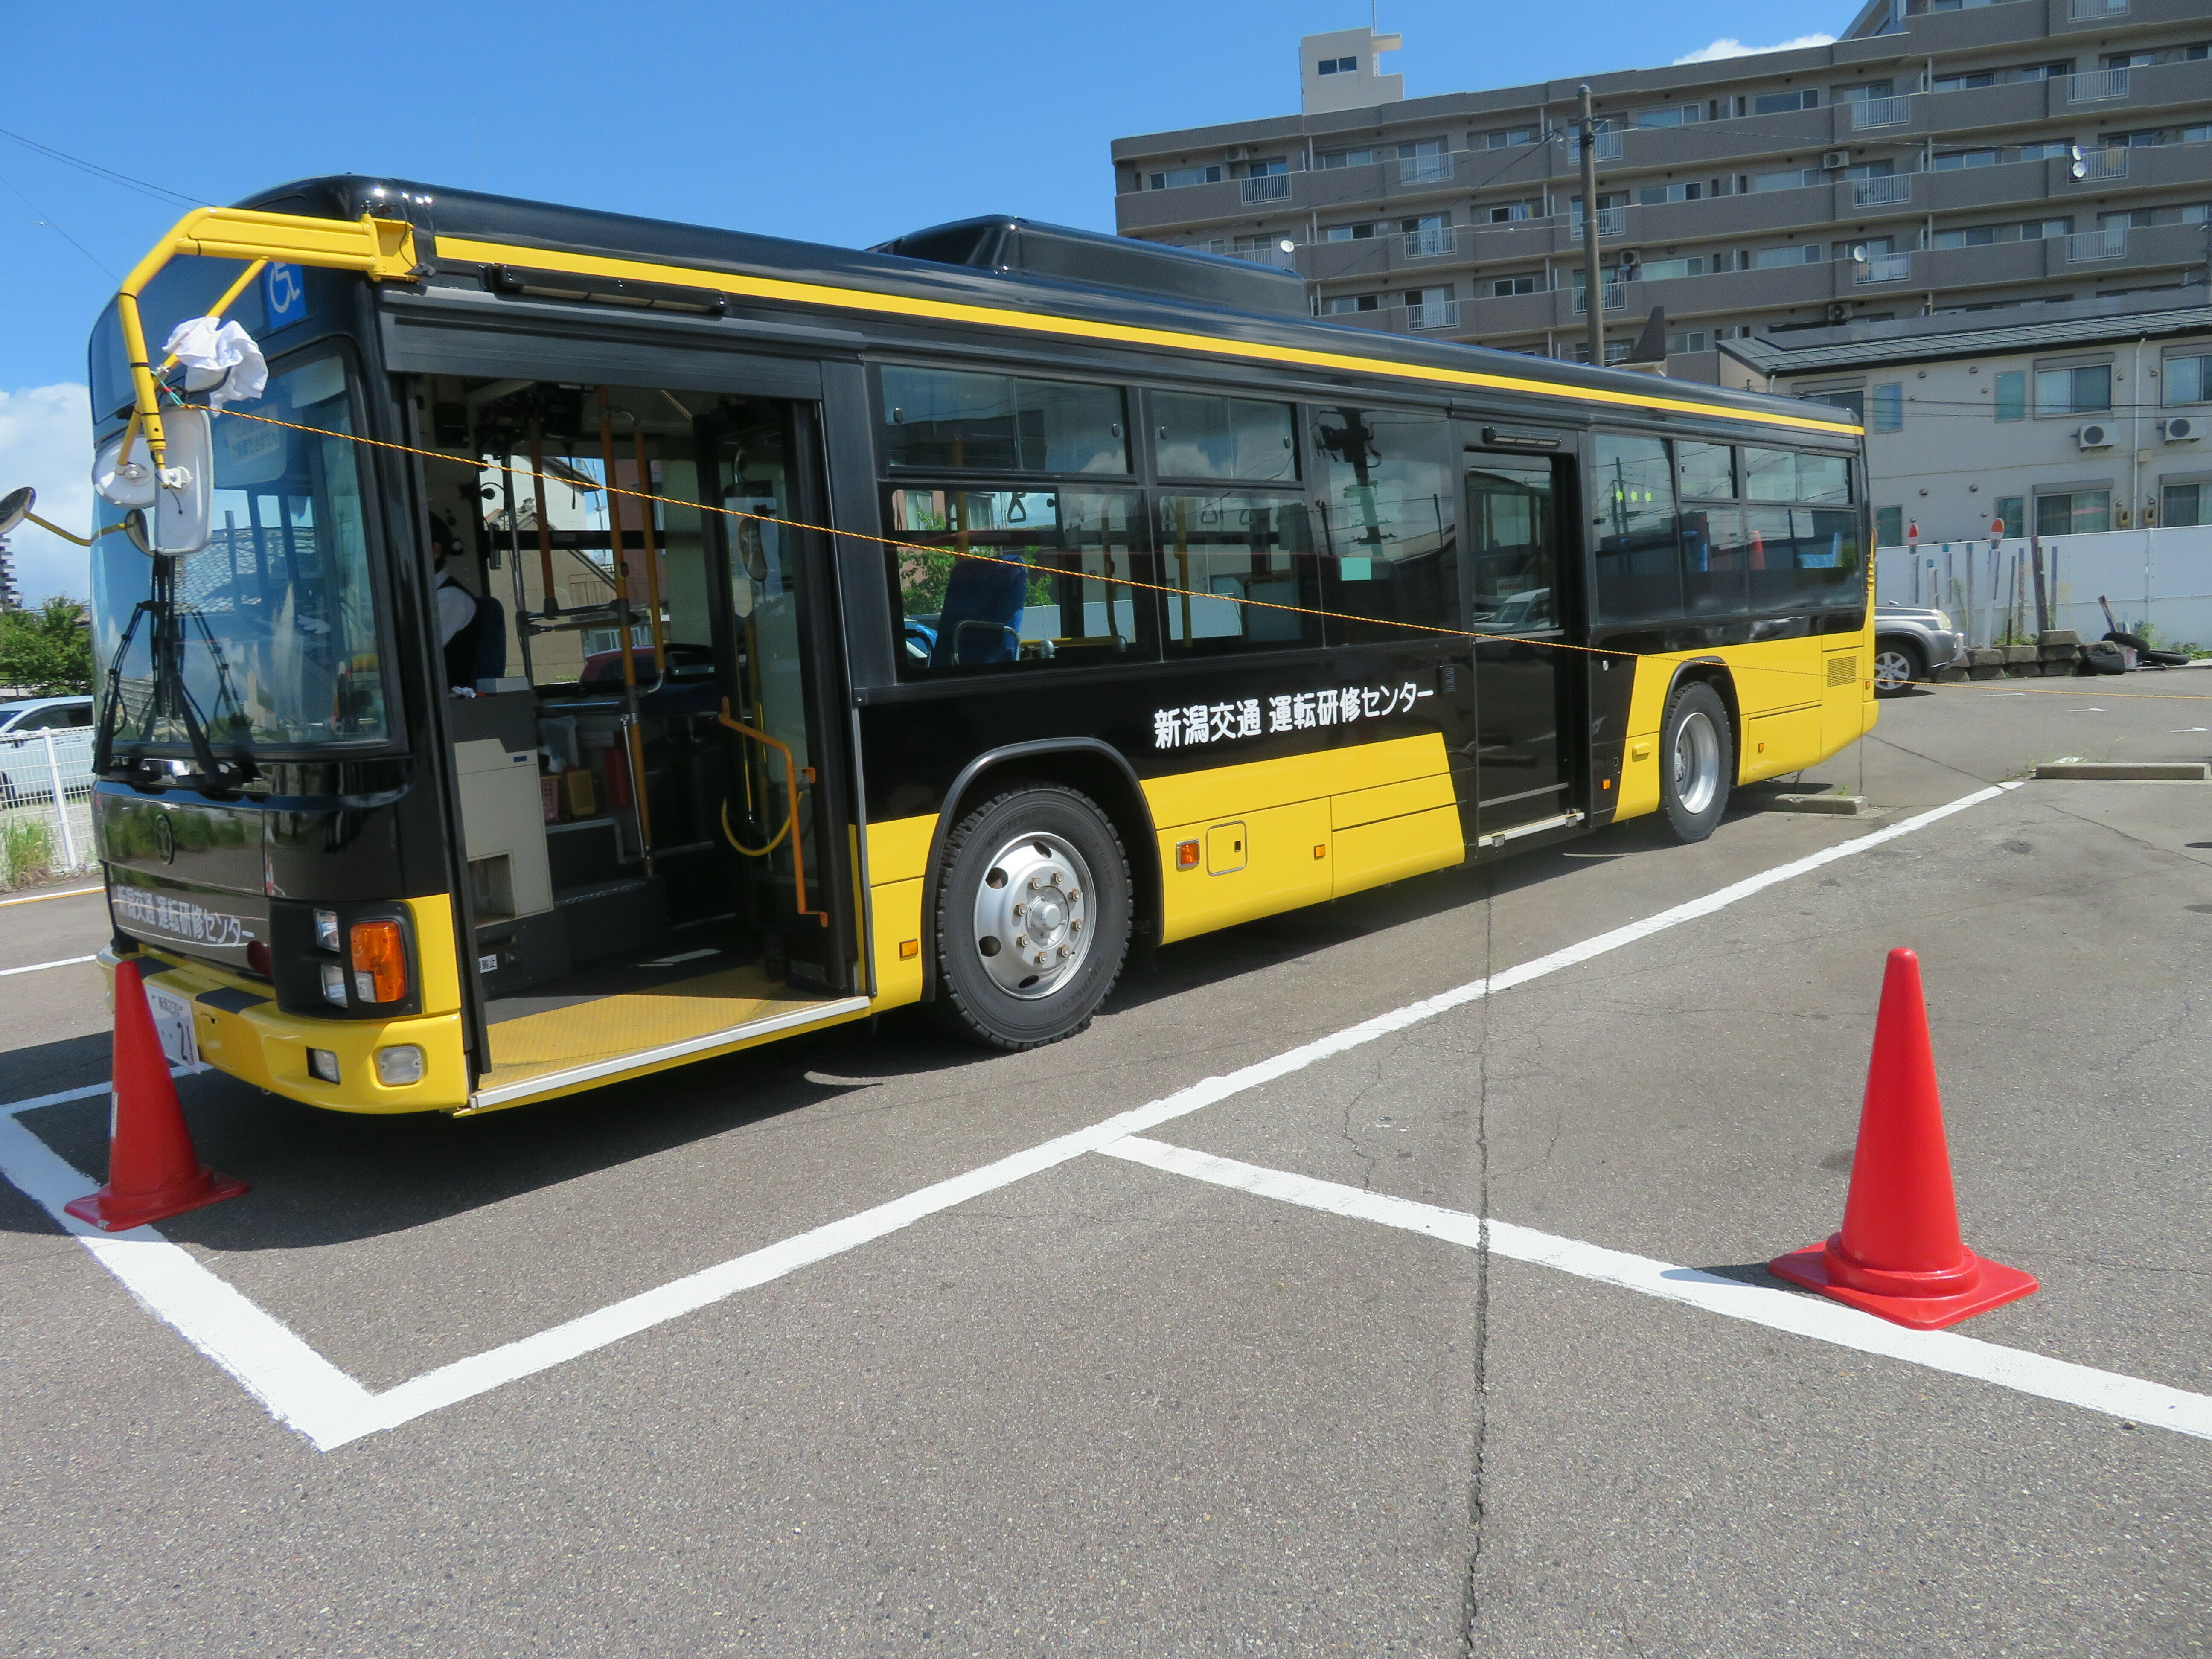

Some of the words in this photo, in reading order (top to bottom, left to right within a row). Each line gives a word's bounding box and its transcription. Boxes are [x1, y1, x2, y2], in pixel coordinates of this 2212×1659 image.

[1154, 699, 1262, 750] 新潟交通
[1269, 681, 1434, 733] 運転研修センター
